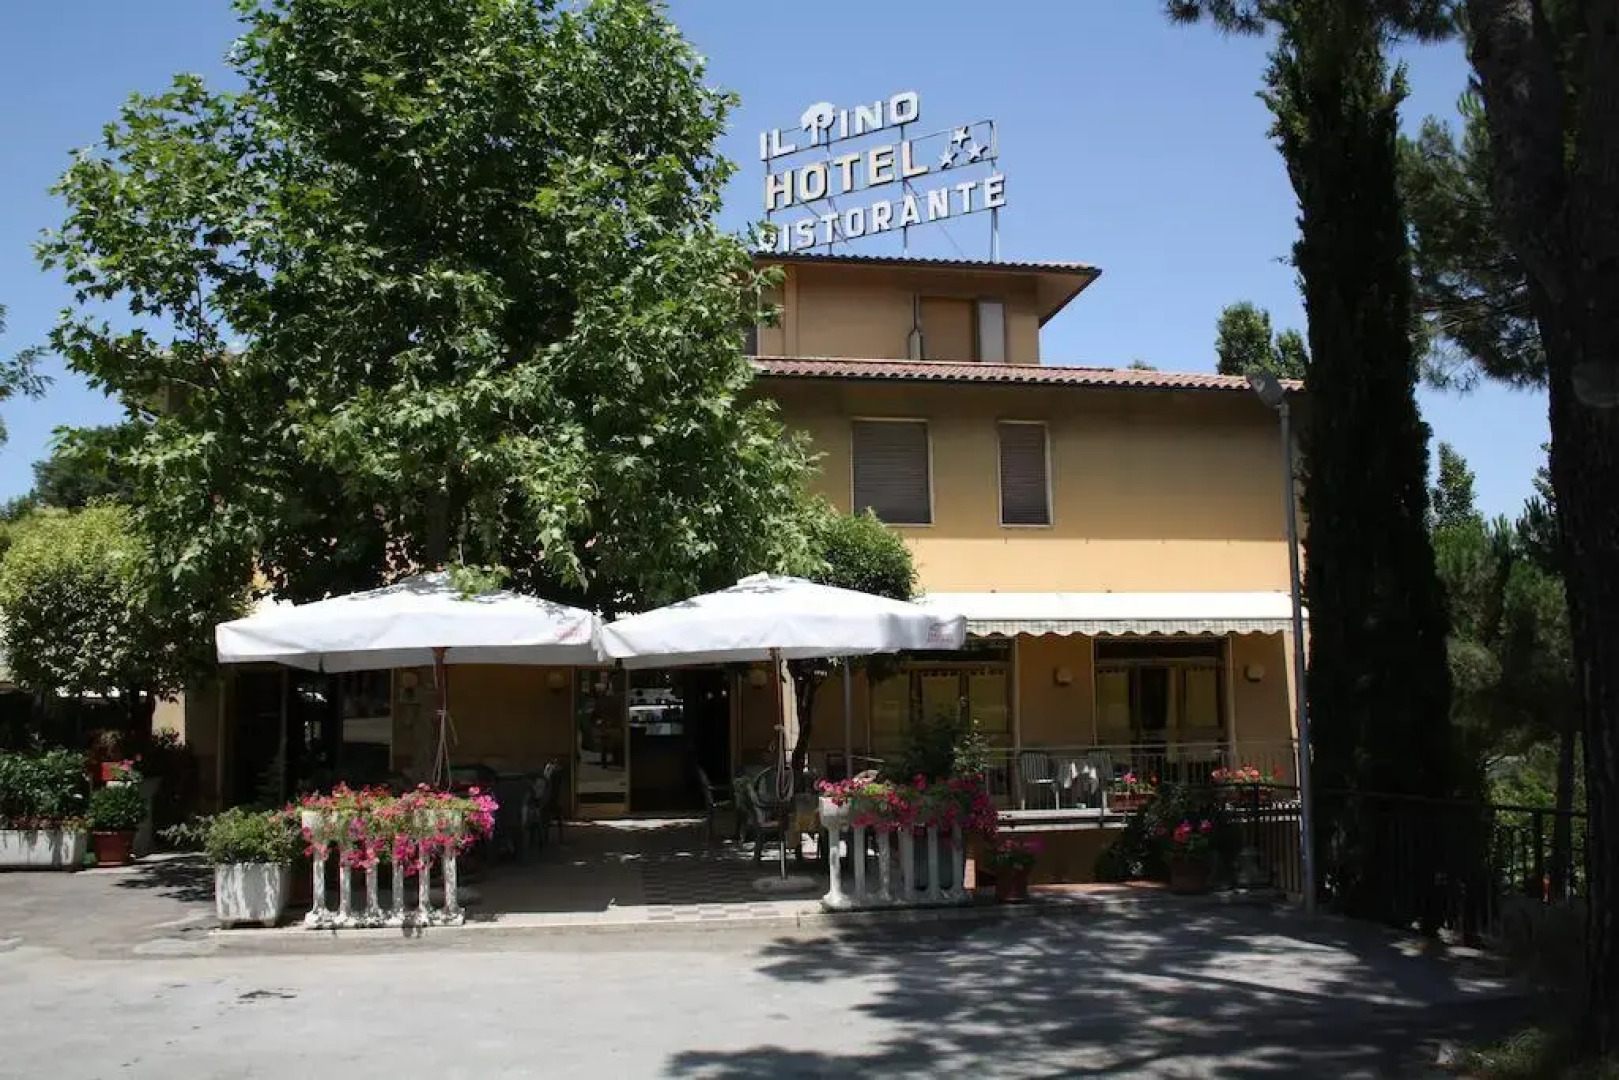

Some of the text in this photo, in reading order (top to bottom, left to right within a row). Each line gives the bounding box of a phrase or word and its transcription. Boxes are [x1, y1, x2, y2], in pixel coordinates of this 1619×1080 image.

[760, 91, 919, 161] IL PINO
[766, 140, 929, 212] HOTEL
[757, 174, 1006, 253] RISTORANTE
